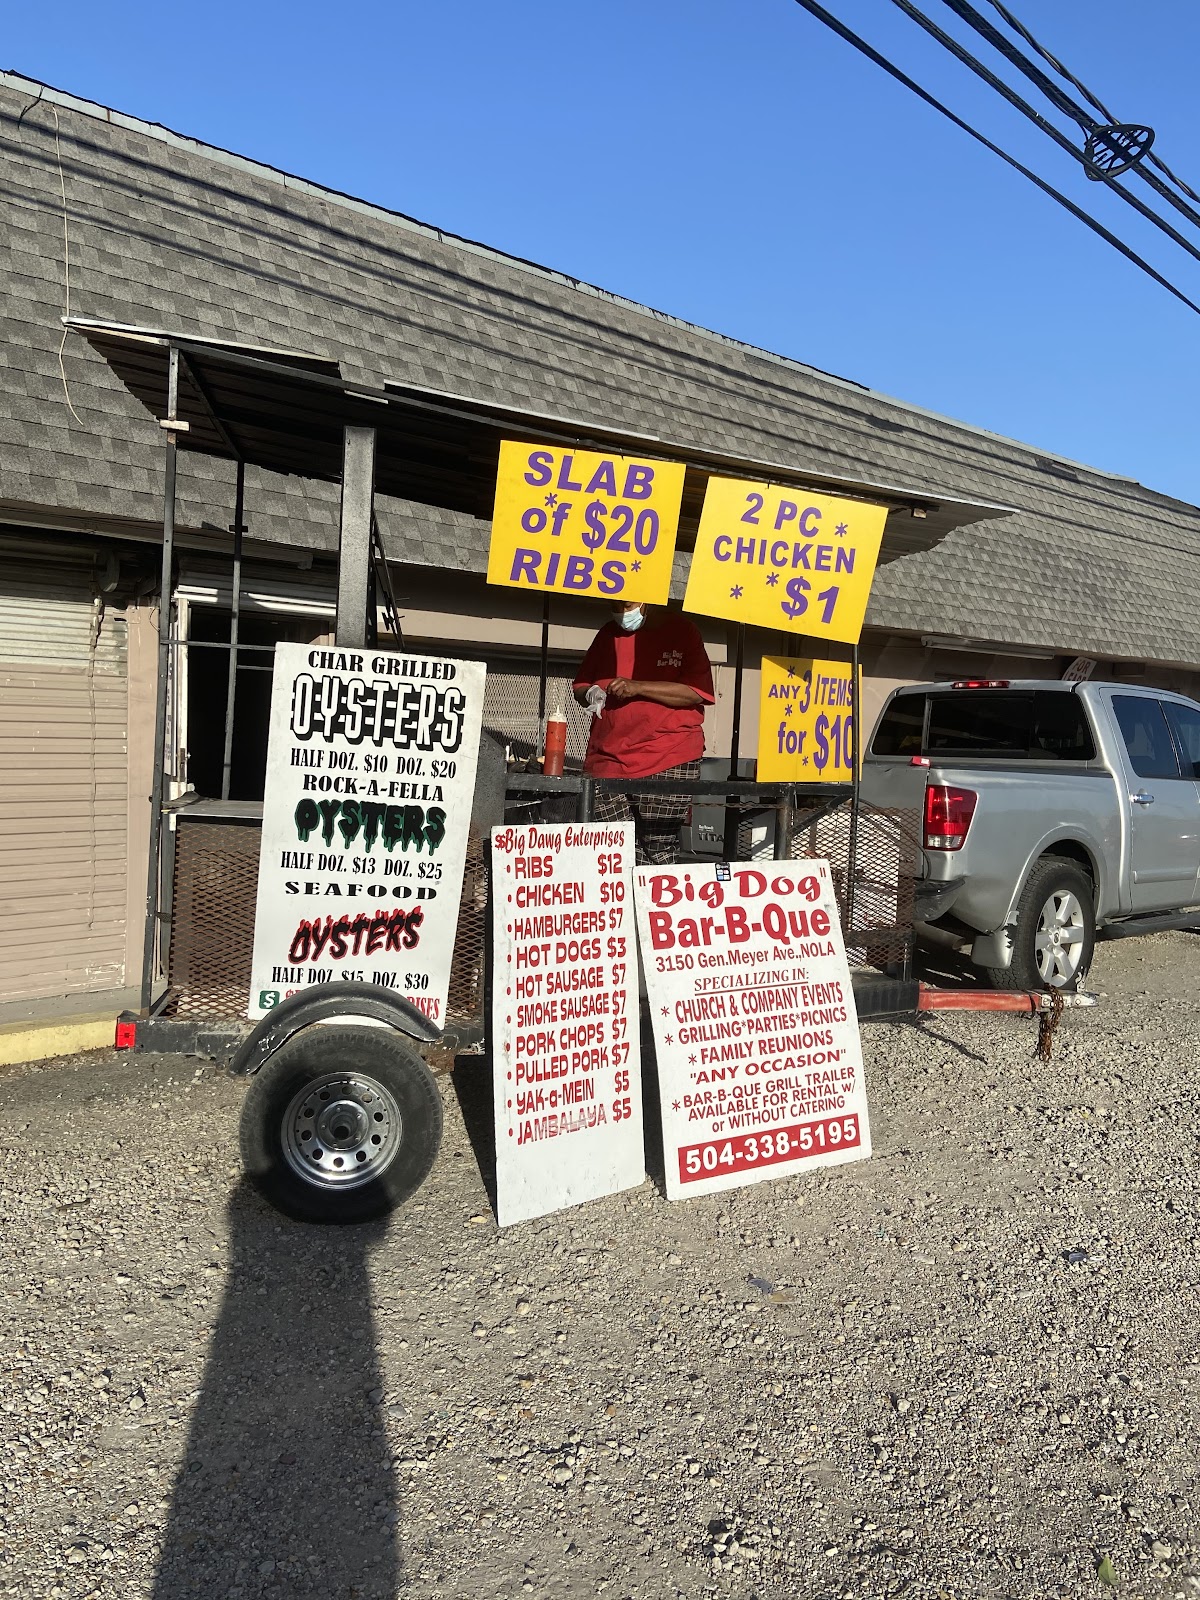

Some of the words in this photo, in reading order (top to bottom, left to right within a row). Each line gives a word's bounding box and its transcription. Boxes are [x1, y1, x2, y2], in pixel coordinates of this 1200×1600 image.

[524, 451, 655, 500] SLAB
[521, 502, 572, 536] of
[581, 499, 660, 556] $20
[740, 492, 764, 525] 2
[773, 500, 822, 538] PC
[713, 534, 856, 574] CHICKEN
[781, 575, 840, 624] $1
[308, 651, 364, 672] CHAR
[372, 657, 456, 680] GRILLED
[768, 684, 800, 699] ANY
[800, 670, 812, 713] 3
[290, 673, 466, 753] OYSTERS
[778, 722, 807, 754] for
[813, 711, 853, 776] $10
[290, 748, 324, 768] HALF
[328, 751, 358, 771] DOZ.
[364, 754, 388, 773] $10
[396, 756, 425, 777] DOZ.
[430, 760, 456, 779] $20
[303, 774, 444, 802] ROCK-A-FELLA
[295, 798, 447, 856] OYSTERS
[528, 827, 562, 854] Dawg
[565, 826, 625, 850] Enterprises
[281, 851, 314, 871] HALF
[318, 854, 347, 872] DOZ.
[352, 856, 376, 874] $13
[384, 859, 412, 878] DOZ.
[418, 862, 443, 880] $25
[514, 856, 553, 879] RIBS
[598, 853, 622, 876] $12
[284, 881, 437, 900] SEAFOOD
[516, 882, 584, 908] CHICKEN
[600, 881, 625, 904] $10
[288, 906, 424, 964] OYSTERS
[514, 910, 605, 940] HAMBURGERS
[609, 908, 623, 930] $7
[648, 903, 831, 950] Bar-B-Que
[516, 943, 550, 969] HOT
[556, 938, 601, 964] DOGS
[607, 936, 626, 960] $3
[656, 954, 694, 973] 3150
[272, 966, 304, 984] HALF
[372, 972, 399, 988] DOZ.
[404, 974, 428, 990] $30
[516, 974, 542, 999] HOT
[547, 966, 604, 995] SAUSAGE
[612, 963, 626, 987] $7
[694, 970, 789, 992] SPECIALIZING
[792, 968, 809, 981] IN:
[517, 1001, 558, 1028] SMOKE
[560, 993, 609, 1020] SAUSAGE
[612, 990, 626, 1016] $7
[675, 995, 726, 1024] CHURCH
[729, 994, 739, 1016] &
[741, 986, 798, 1014] COMPANY
[801, 982, 843, 1007] EVENTS
[516, 1030, 556, 1059] PORK
[560, 1022, 604, 1050] CHOPS
[612, 1018, 627, 1041] $7
[701, 1040, 754, 1064] FAMILY
[758, 1029, 833, 1055] REUNIONS
[516, 1054, 568, 1086] PULLED
[572, 1046, 609, 1074] PORK
[612, 1042, 630, 1067] $7
[516, 1078, 594, 1115] YAK-a-MEIN
[614, 1070, 629, 1094] $5
[684, 1082, 761, 1108] BAR-B-QUE
[766, 1076, 801, 1093] GRILL
[804, 1067, 854, 1086] TRAILER
[689, 1098, 758, 1121] AVAILABLE
[763, 1090, 788, 1106] FOR
[793, 1083, 838, 1101] RENTAL
[517, 1103, 607, 1145] JAMBALAYA
[613, 1097, 632, 1123] $5
[712, 1119, 724, 1133] or
[728, 1106, 786, 1130] WITHOUT
[790, 1095, 845, 1118] CATERING
[686, 1118, 856, 1174] 504-338-5195
